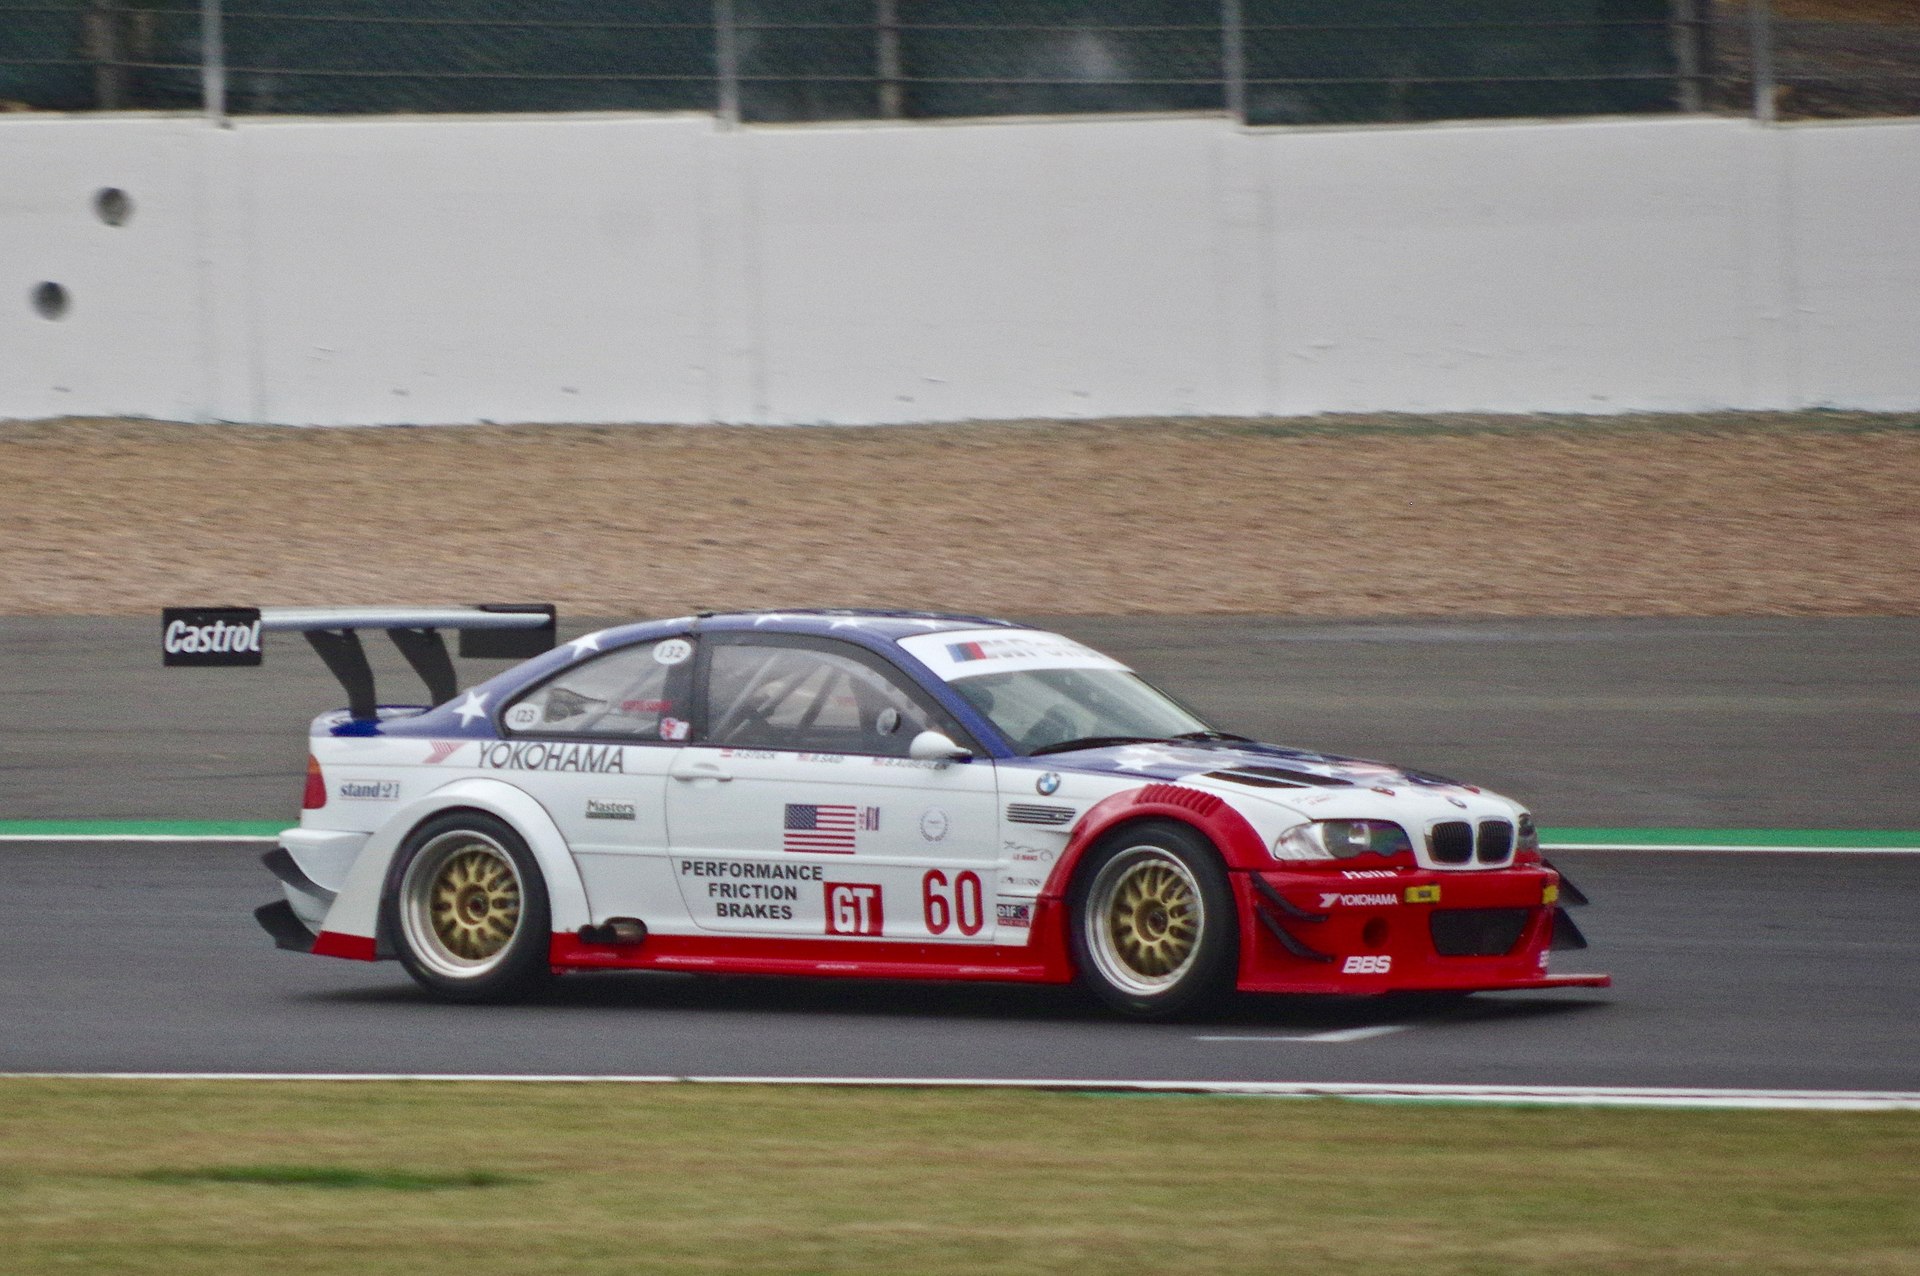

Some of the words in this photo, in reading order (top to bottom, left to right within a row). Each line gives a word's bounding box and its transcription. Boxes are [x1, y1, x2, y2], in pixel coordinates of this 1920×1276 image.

[165, 620, 260, 654] Castrol
[478, 743, 623, 773] YOKOHAMA
[587, 800, 635, 812] Masters
[682, 861, 824, 881] PERFORMANCE
[708, 882, 798, 901] FRICTION
[1340, 893, 1398, 906] YOKOHAMA
[716, 902, 793, 920] BRAKES
[831, 886, 876, 935] GT
[922, 869, 984, 936] 60
[997, 905, 1017, 918] elf
[1342, 955, 1391, 974] BBS
